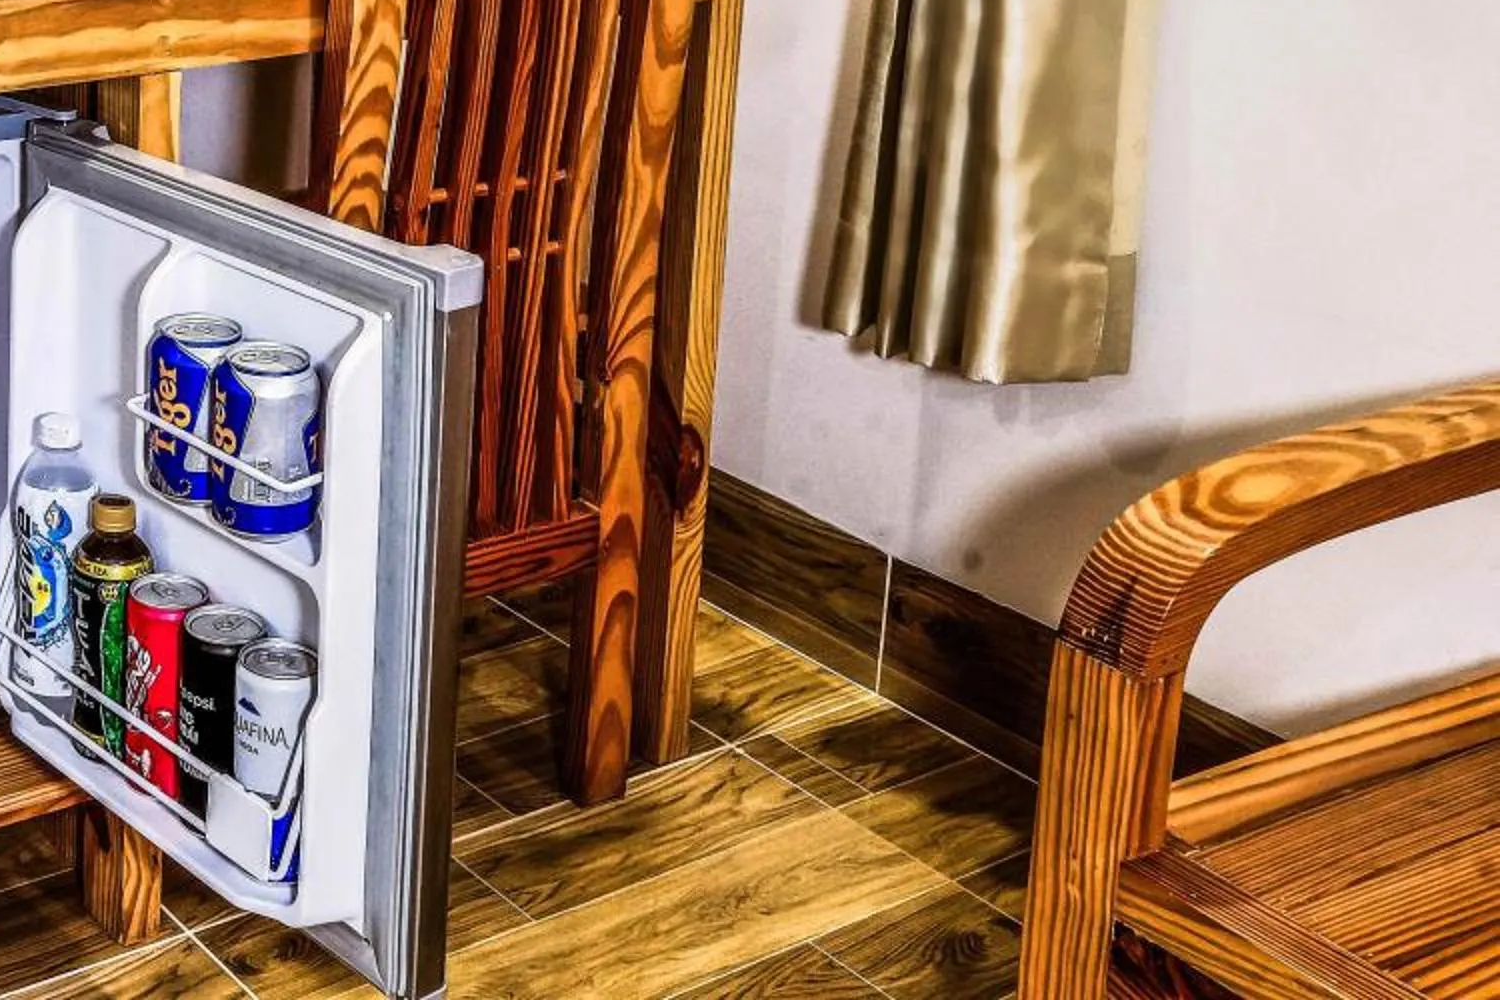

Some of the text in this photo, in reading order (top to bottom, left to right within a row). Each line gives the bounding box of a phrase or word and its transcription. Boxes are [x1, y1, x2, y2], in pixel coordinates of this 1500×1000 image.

[153, 357, 191, 456] Tger
[211, 379, 237, 482] Tger
[235, 711, 290, 751] UAFINA
